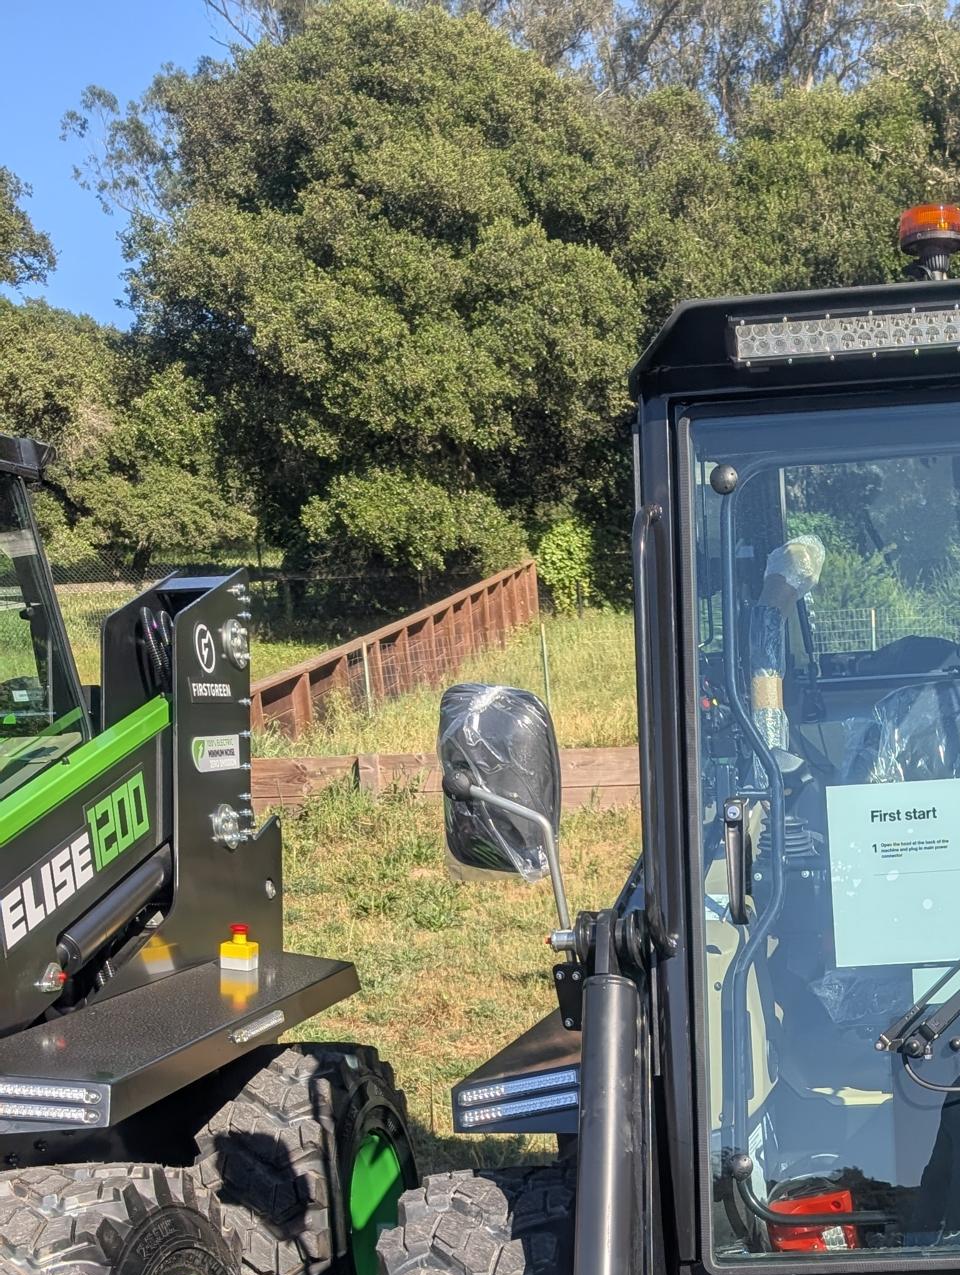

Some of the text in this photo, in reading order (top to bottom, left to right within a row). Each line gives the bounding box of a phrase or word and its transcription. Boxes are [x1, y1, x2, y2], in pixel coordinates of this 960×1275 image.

[192, 683, 231, 697] FIRSTGREEN
[871, 807, 937, 823] First start
[872, 843, 877, 853] 1
[1, 771, 150, 950] ELISE 1200
